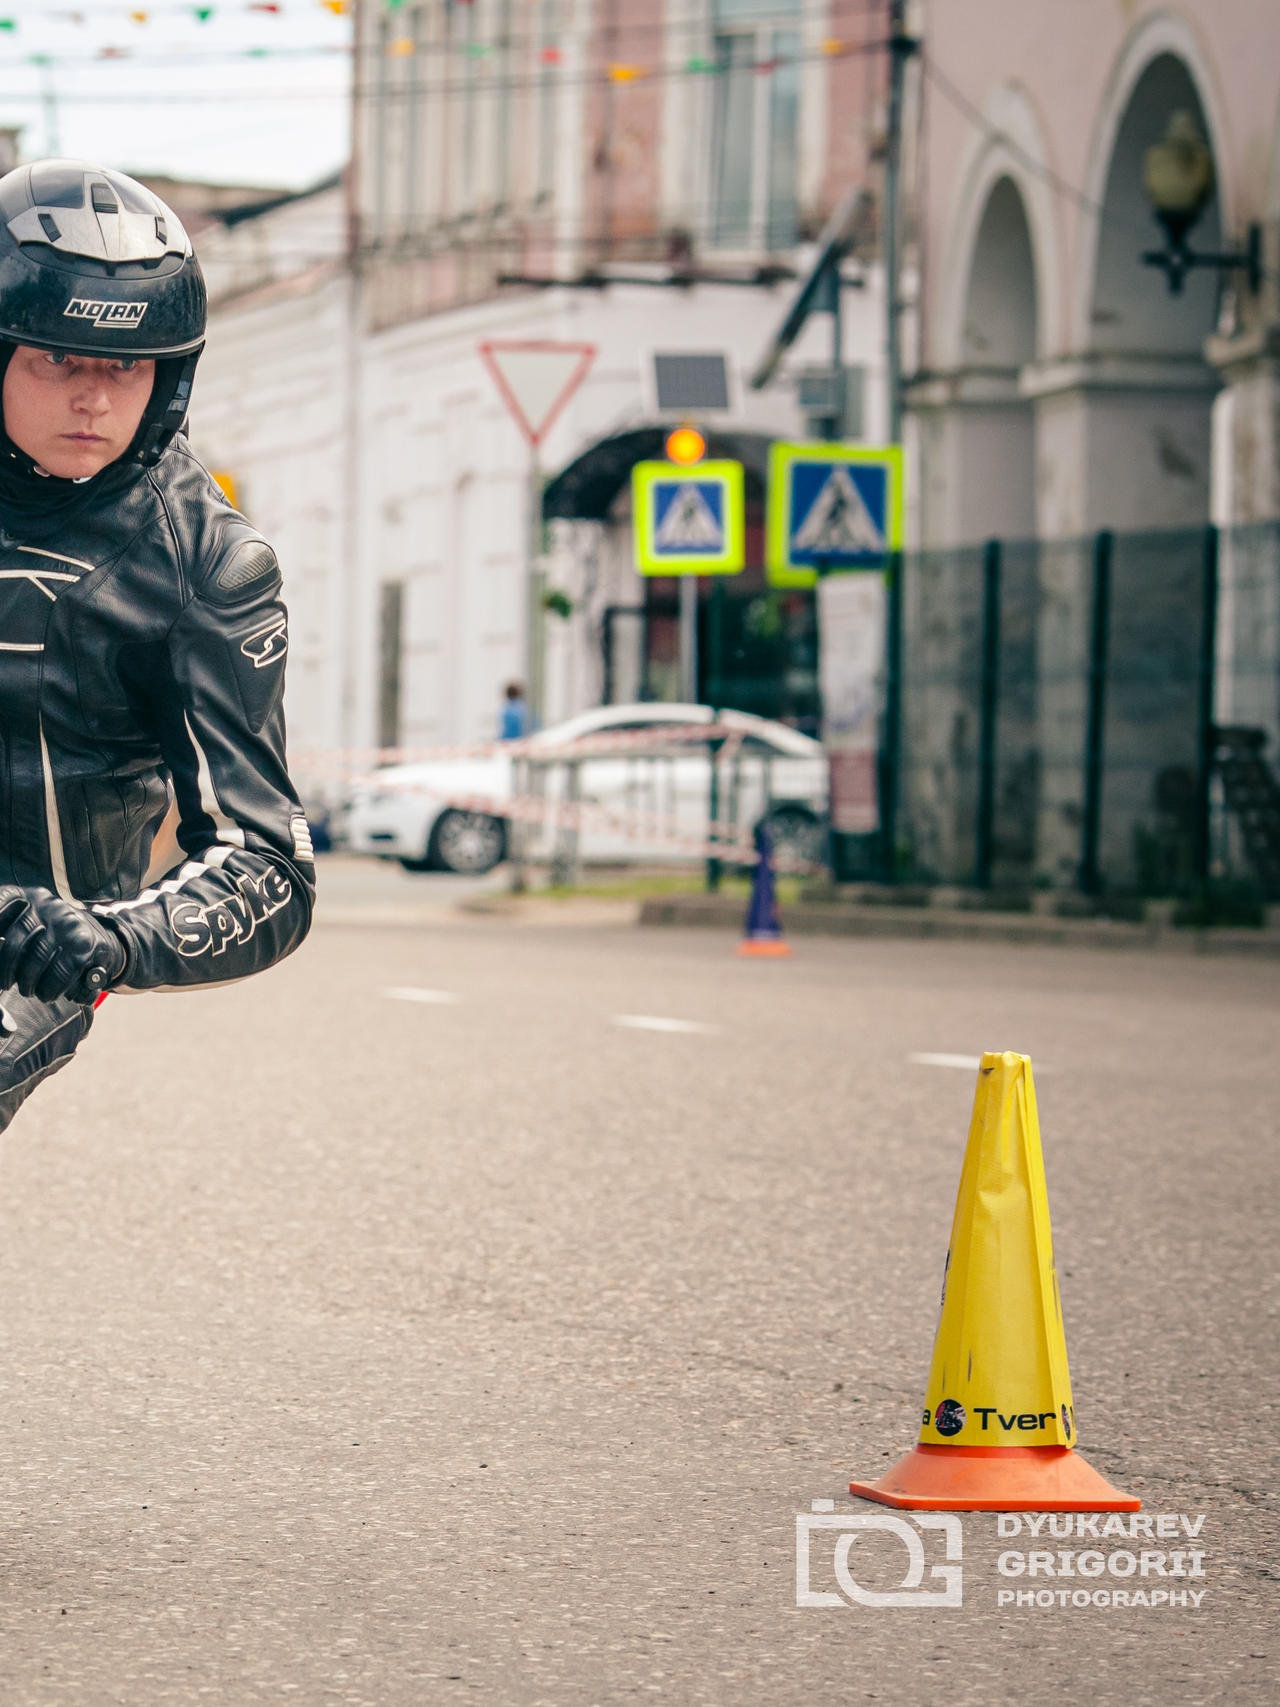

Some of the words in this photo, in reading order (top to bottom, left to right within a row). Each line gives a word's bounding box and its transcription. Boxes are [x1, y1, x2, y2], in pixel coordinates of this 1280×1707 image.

[63, 298, 148, 328] NOLAN
[170, 865, 293, 957] Spyke
[973, 1407, 1057, 1430] Tver
